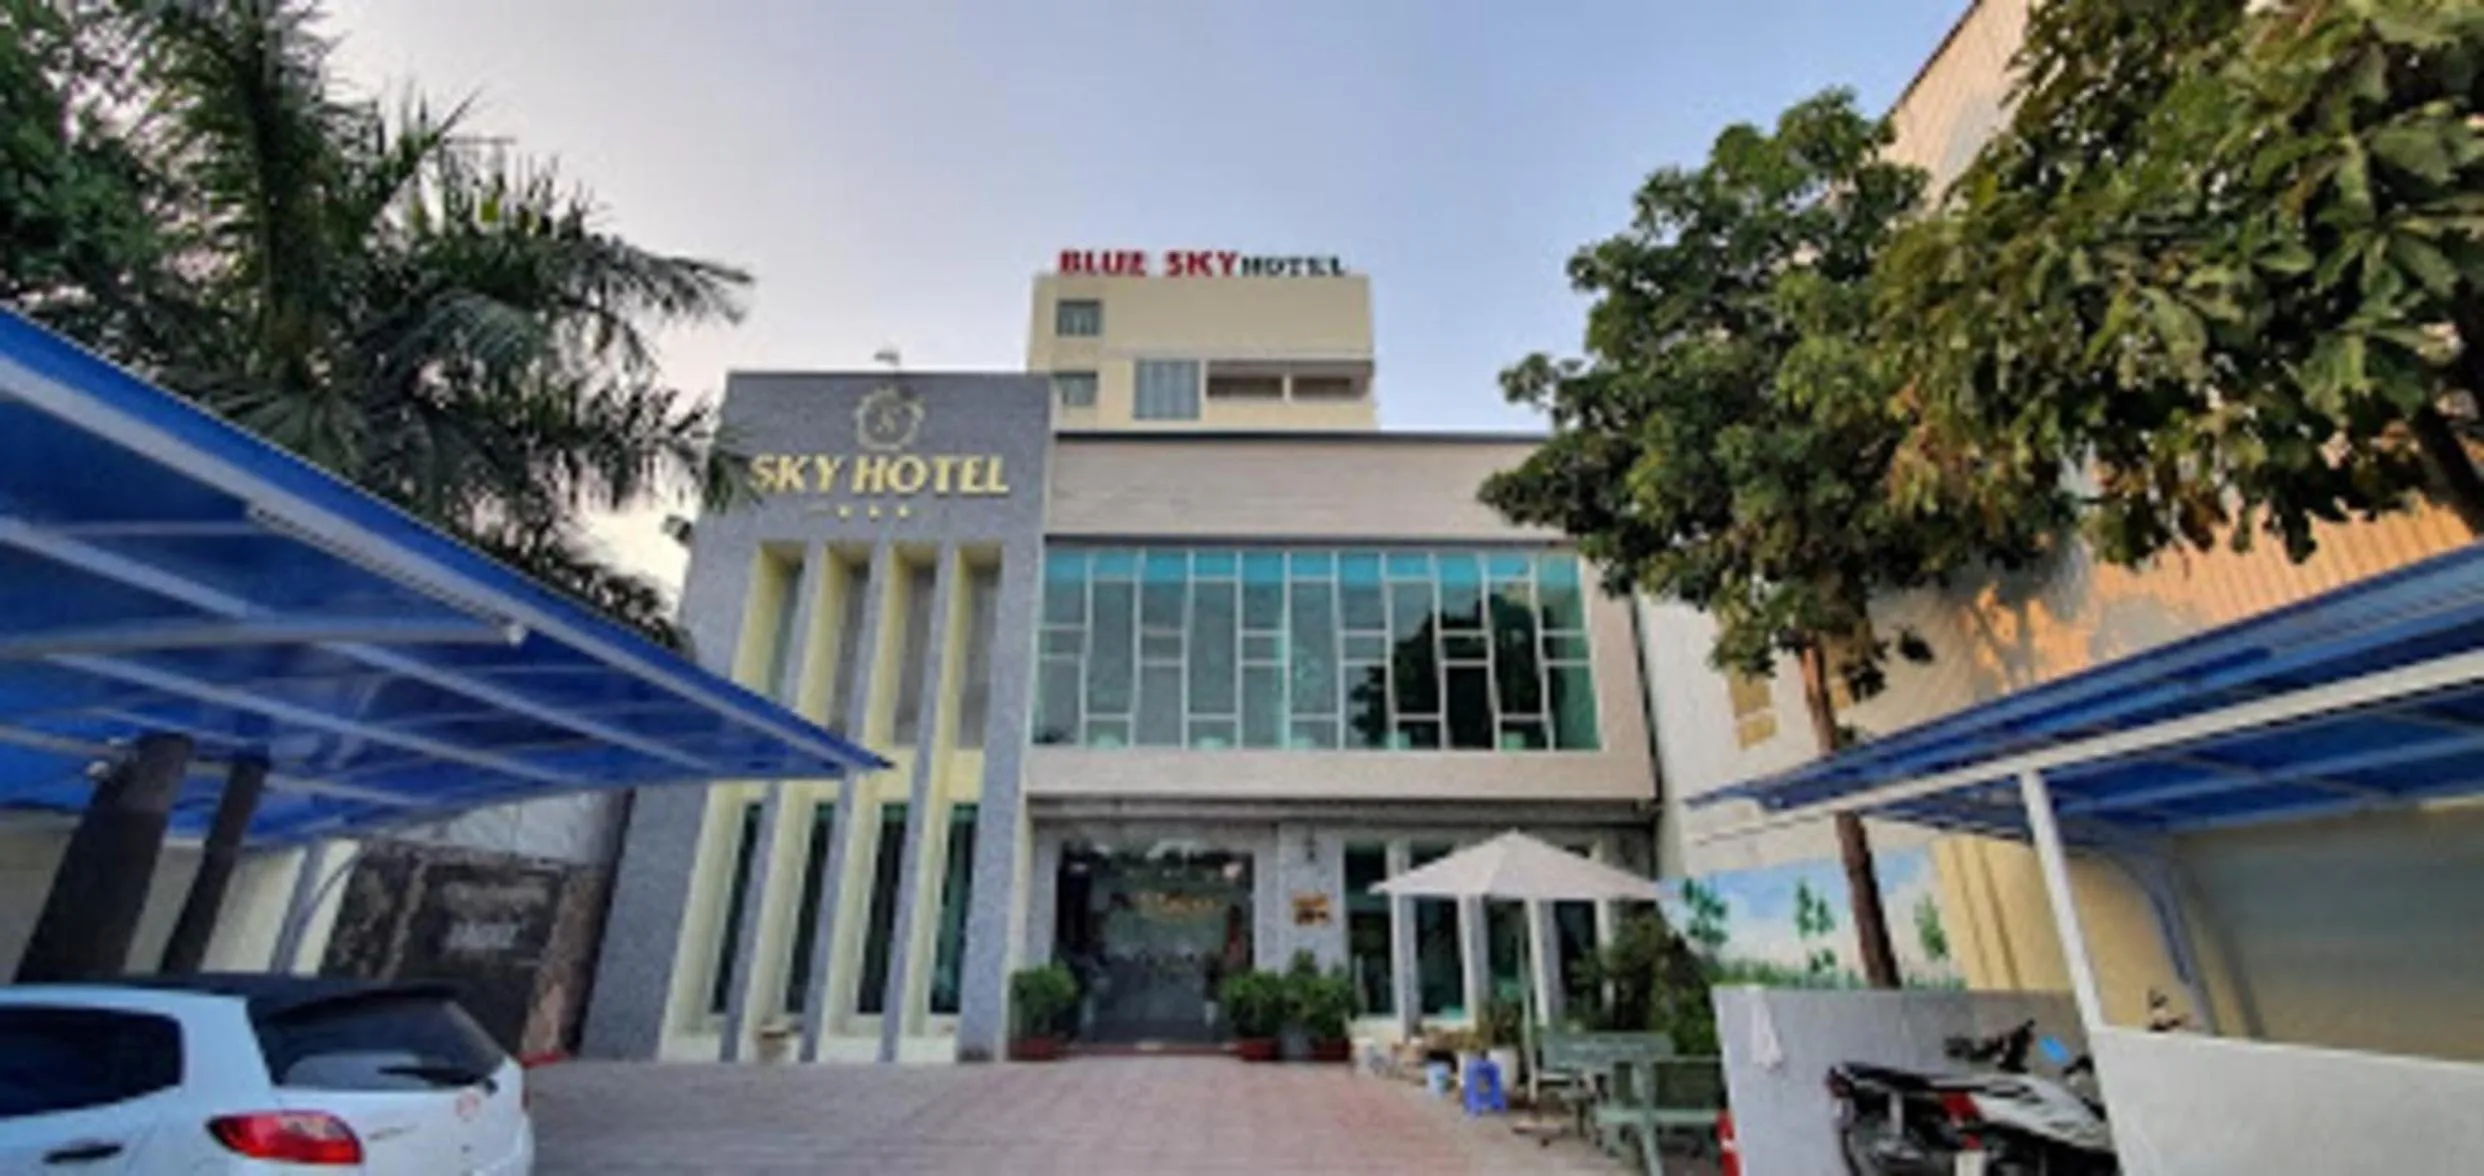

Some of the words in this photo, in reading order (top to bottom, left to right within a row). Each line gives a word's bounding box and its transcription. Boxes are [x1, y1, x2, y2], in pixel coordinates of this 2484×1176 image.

[1058, 250, 1148, 276] BLUE
[1164, 250, 1238, 277] SKY
[1240, 256, 1346, 277] HOTEL
[750, 453, 845, 493] SKY
[851, 454, 1010, 494] HOTEL
